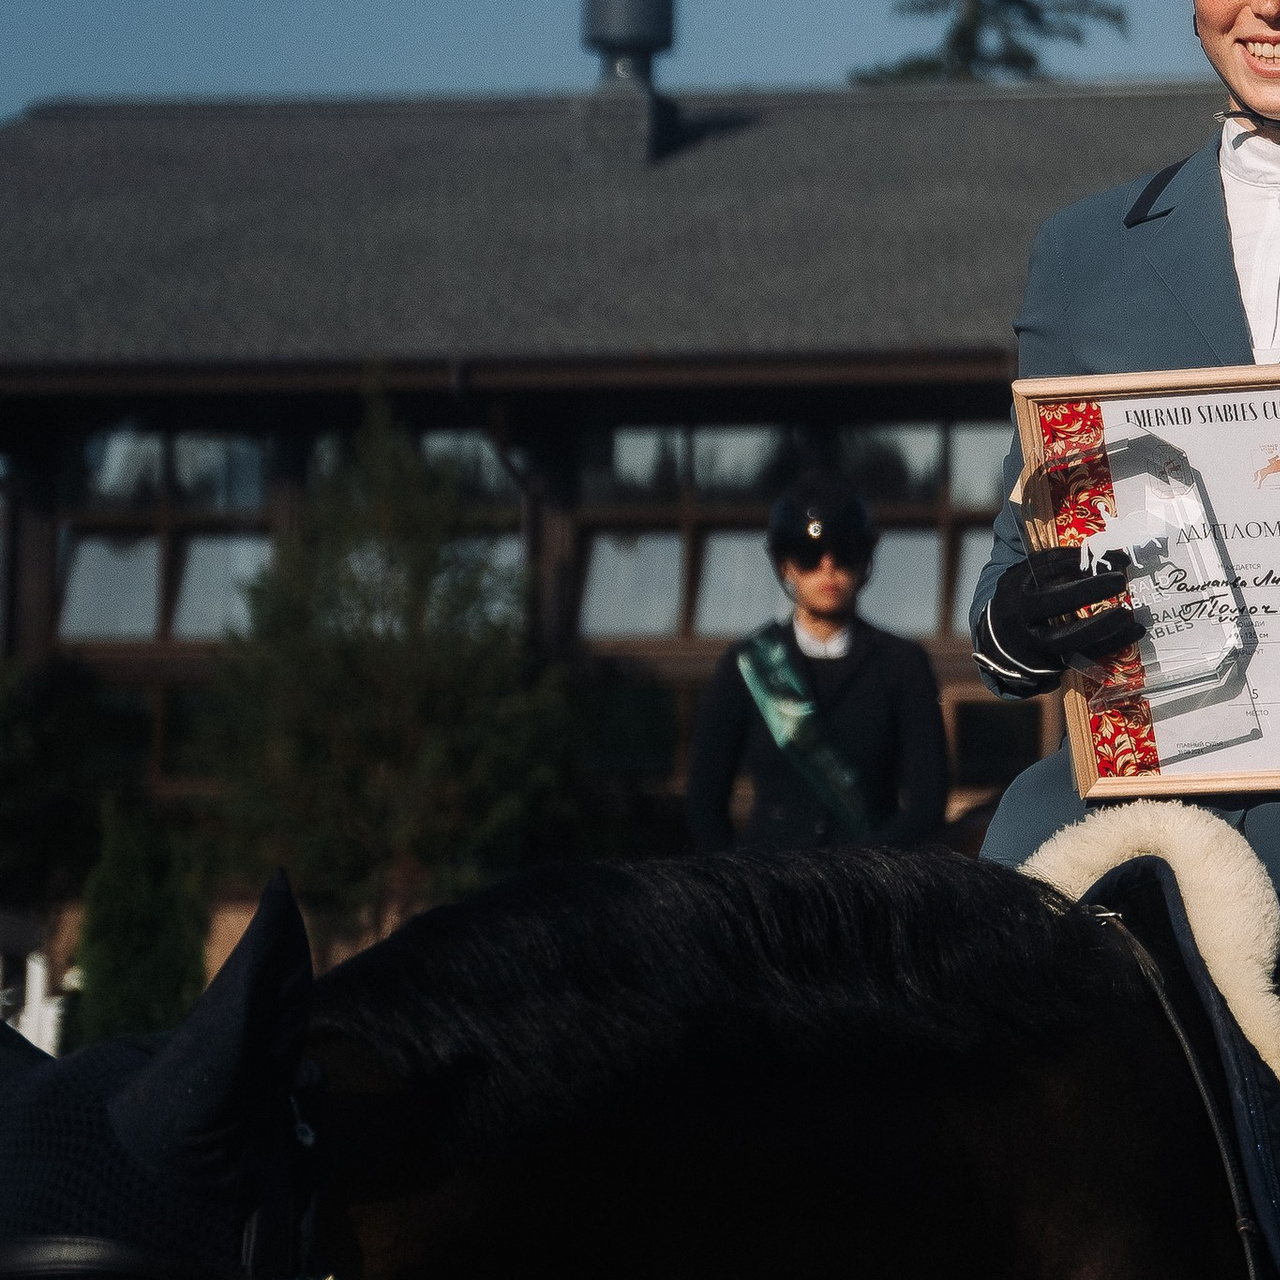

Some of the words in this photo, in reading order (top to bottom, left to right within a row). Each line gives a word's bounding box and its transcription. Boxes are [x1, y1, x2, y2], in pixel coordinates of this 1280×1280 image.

[1125, 406, 1192, 428] EMERALD
[1197, 402, 1258, 424] STABLES
[1252, 689, 1259, 700] 5
